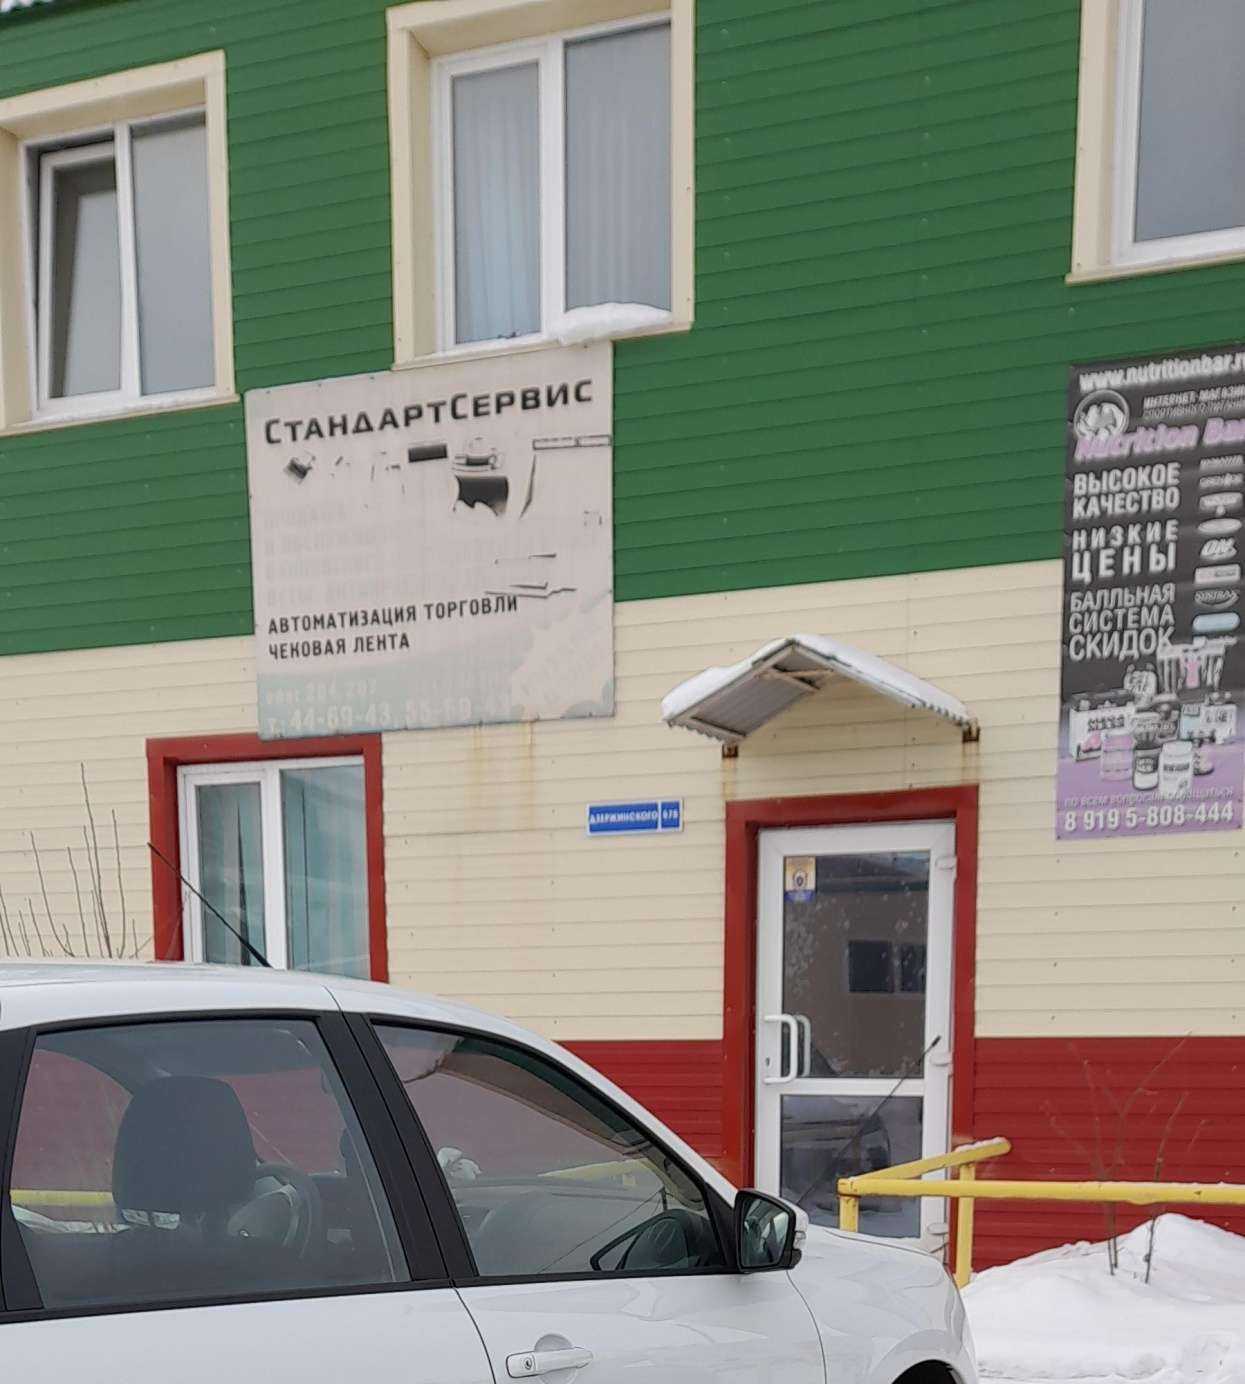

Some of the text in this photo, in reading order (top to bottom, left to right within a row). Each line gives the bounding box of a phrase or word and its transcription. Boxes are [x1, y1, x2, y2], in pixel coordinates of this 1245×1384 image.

[1079, 352, 1245, 394] www.nutritionbar.r
[1075, 424, 1200, 460] Nutrition
[1073, 462, 1181, 496] ВЫСОКОЕ
[1073, 486, 1180, 519] КАЧЕСТВО
[1073, 519, 1179, 550] НИЗКИЕ
[1072, 542, 1176, 584] ЦЕНЫ
[1070, 582, 1176, 612] БАЛЛЬНАЯ
[267, 604, 417, 635] АВТОМАТИЗАЦИЯ
[424, 594, 519, 621] ТОРГОВЛИ
[1069, 604, 1175, 634] СИСТЕМА
[268, 634, 410, 661] ЧЕКОВАЯ ЛЕНТА
[1069, 626, 1175, 661] СКИДОК
[1065, 801, 1234, 832] 8 919 5-808-444
